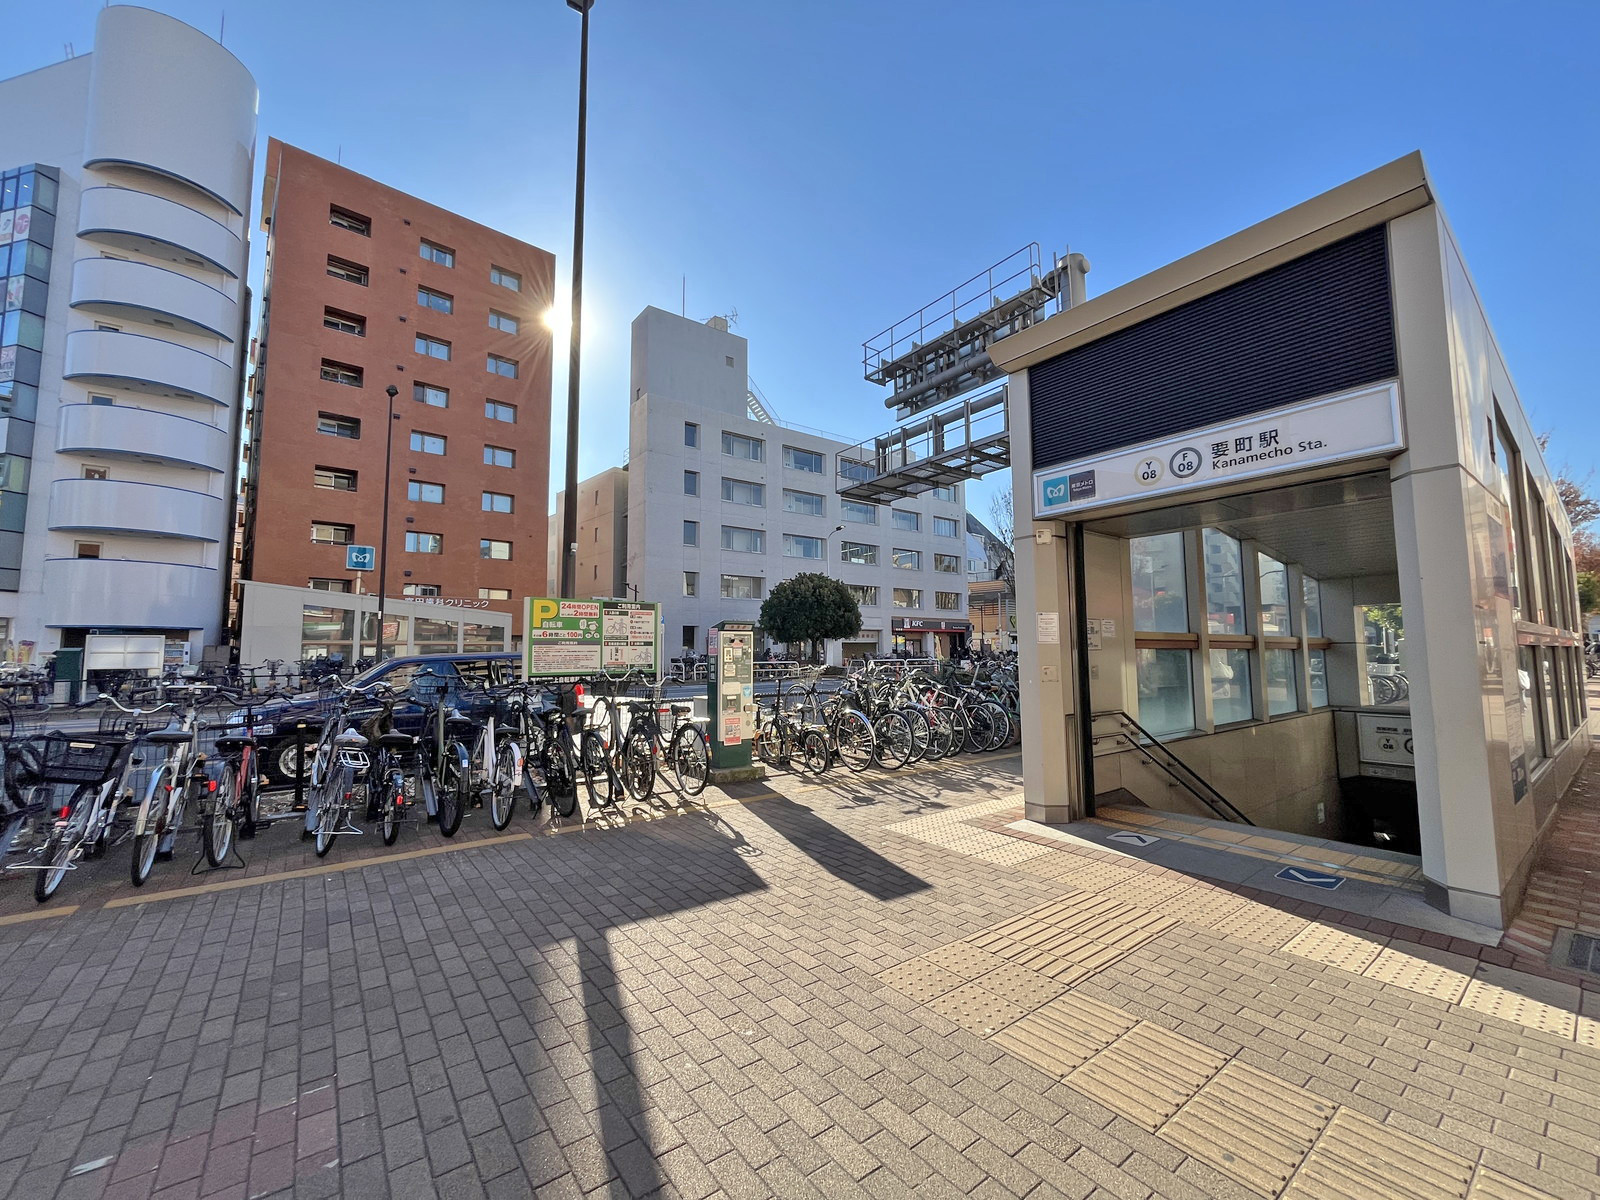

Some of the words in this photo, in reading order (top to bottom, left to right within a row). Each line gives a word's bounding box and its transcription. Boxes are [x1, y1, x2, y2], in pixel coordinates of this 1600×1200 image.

[1211, 429, 1279, 459] 要町駅
[1182, 453, 1188, 461] F
[1212, 446, 1293, 470] Kanamecho
[1298, 440, 1327, 453] Sta.
[1145, 461, 1152, 469] Y
[1178, 461, 1193, 472] 08
[1142, 470, 1156, 480] 08
[532, 600, 558, 628] P
